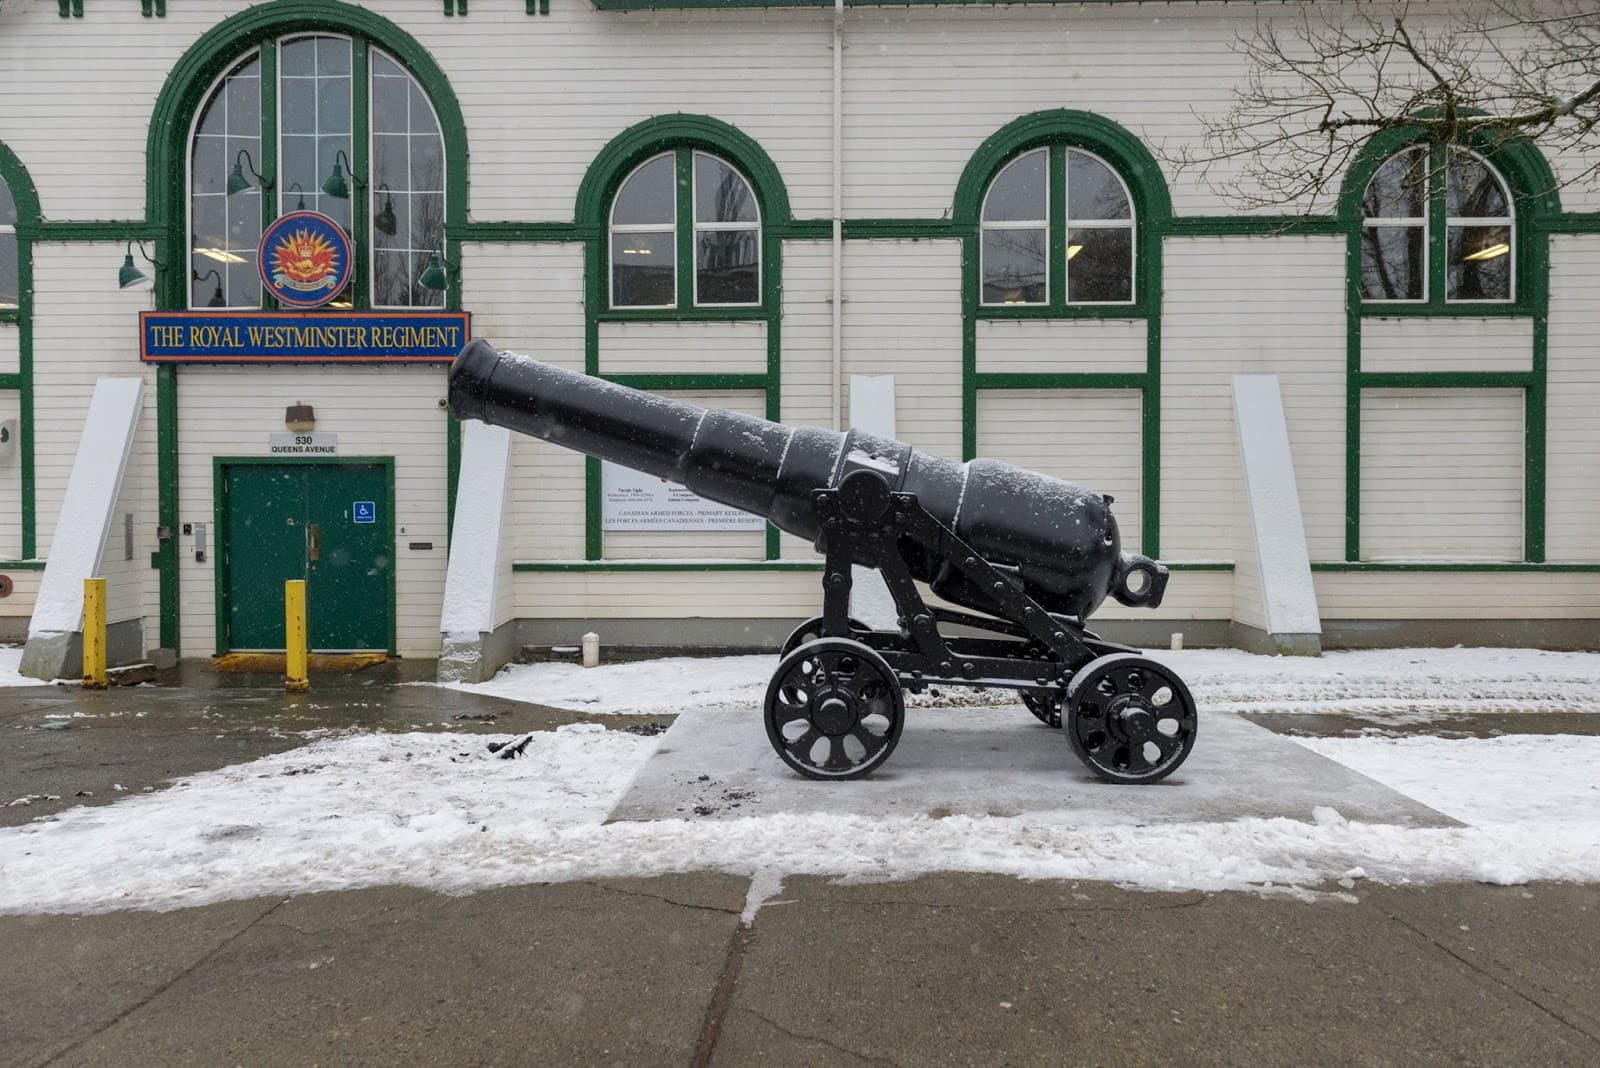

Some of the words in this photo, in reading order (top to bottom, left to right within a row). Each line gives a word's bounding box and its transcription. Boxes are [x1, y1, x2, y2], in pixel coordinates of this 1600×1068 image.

[150, 326, 184, 348] THE
[191, 326, 245, 348] ROYAL
[247, 326, 368, 348] WESTMINSTER
[370, 326, 460, 348] REGIMENT
[295, 436, 313, 445] 530
